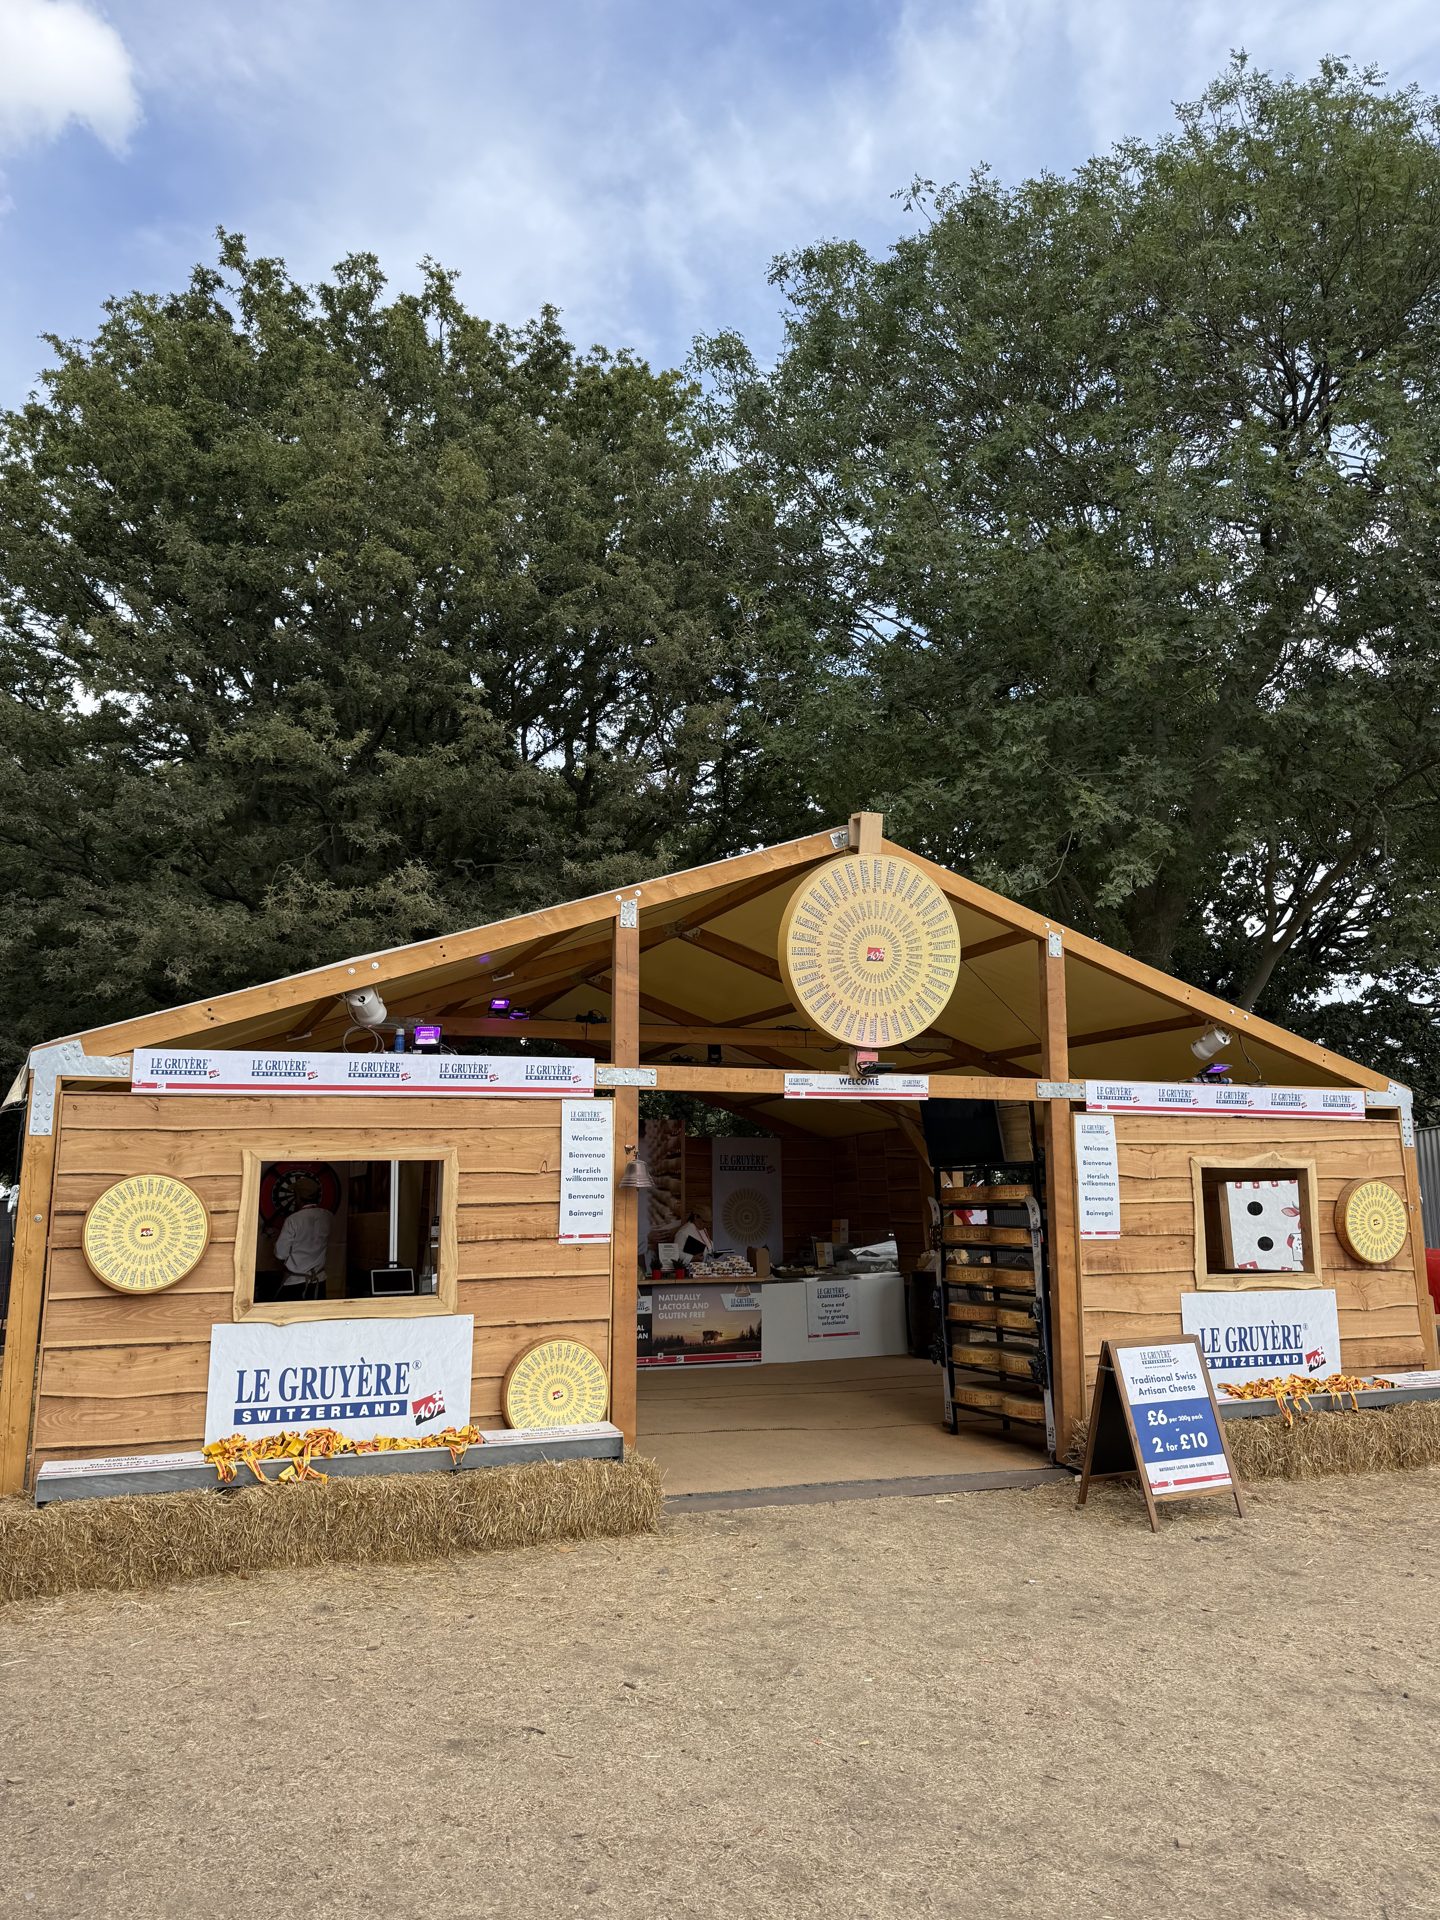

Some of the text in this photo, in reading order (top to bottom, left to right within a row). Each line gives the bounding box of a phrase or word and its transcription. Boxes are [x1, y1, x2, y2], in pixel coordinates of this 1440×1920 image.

[151, 1057, 209, 1070] LE GRUYÈRE
[252, 1059, 307, 1071] LE GRUYÈRE
[349, 1060, 400, 1072] LE GRUYÈRE
[440, 1062, 488, 1074] LE GRUYÈRE
[526, 1064, 572, 1075] LE GRUYÈRE
[839, 1078, 879, 1086] WELCOME
[1096, 1086, 1132, 1096] LE GRUYÈRE
[1158, 1088, 1165, 1097] LE
[1216, 1091, 1222, 1100] LE
[1271, 1093, 1277, 1101] LE
[1323, 1094, 1328, 1102] LE
[720, 1152, 765, 1165] LE GRUYÈRE
[1200, 1327, 1221, 1353] LE
[1206, 1356, 1298, 1368] SWITZERLAND
[1130, 1372, 1197, 1385] Traditional Swiss
[235, 1368, 270, 1403] LE
[1138, 1384, 1196, 1396] Artisan Cheese
[242, 1404, 400, 1422] SWITZERLAND
[414, 1400, 446, 1420] AOP
[1147, 1410, 1168, 1426] £6
[1152, 1432, 1208, 1453] 2 for £10
